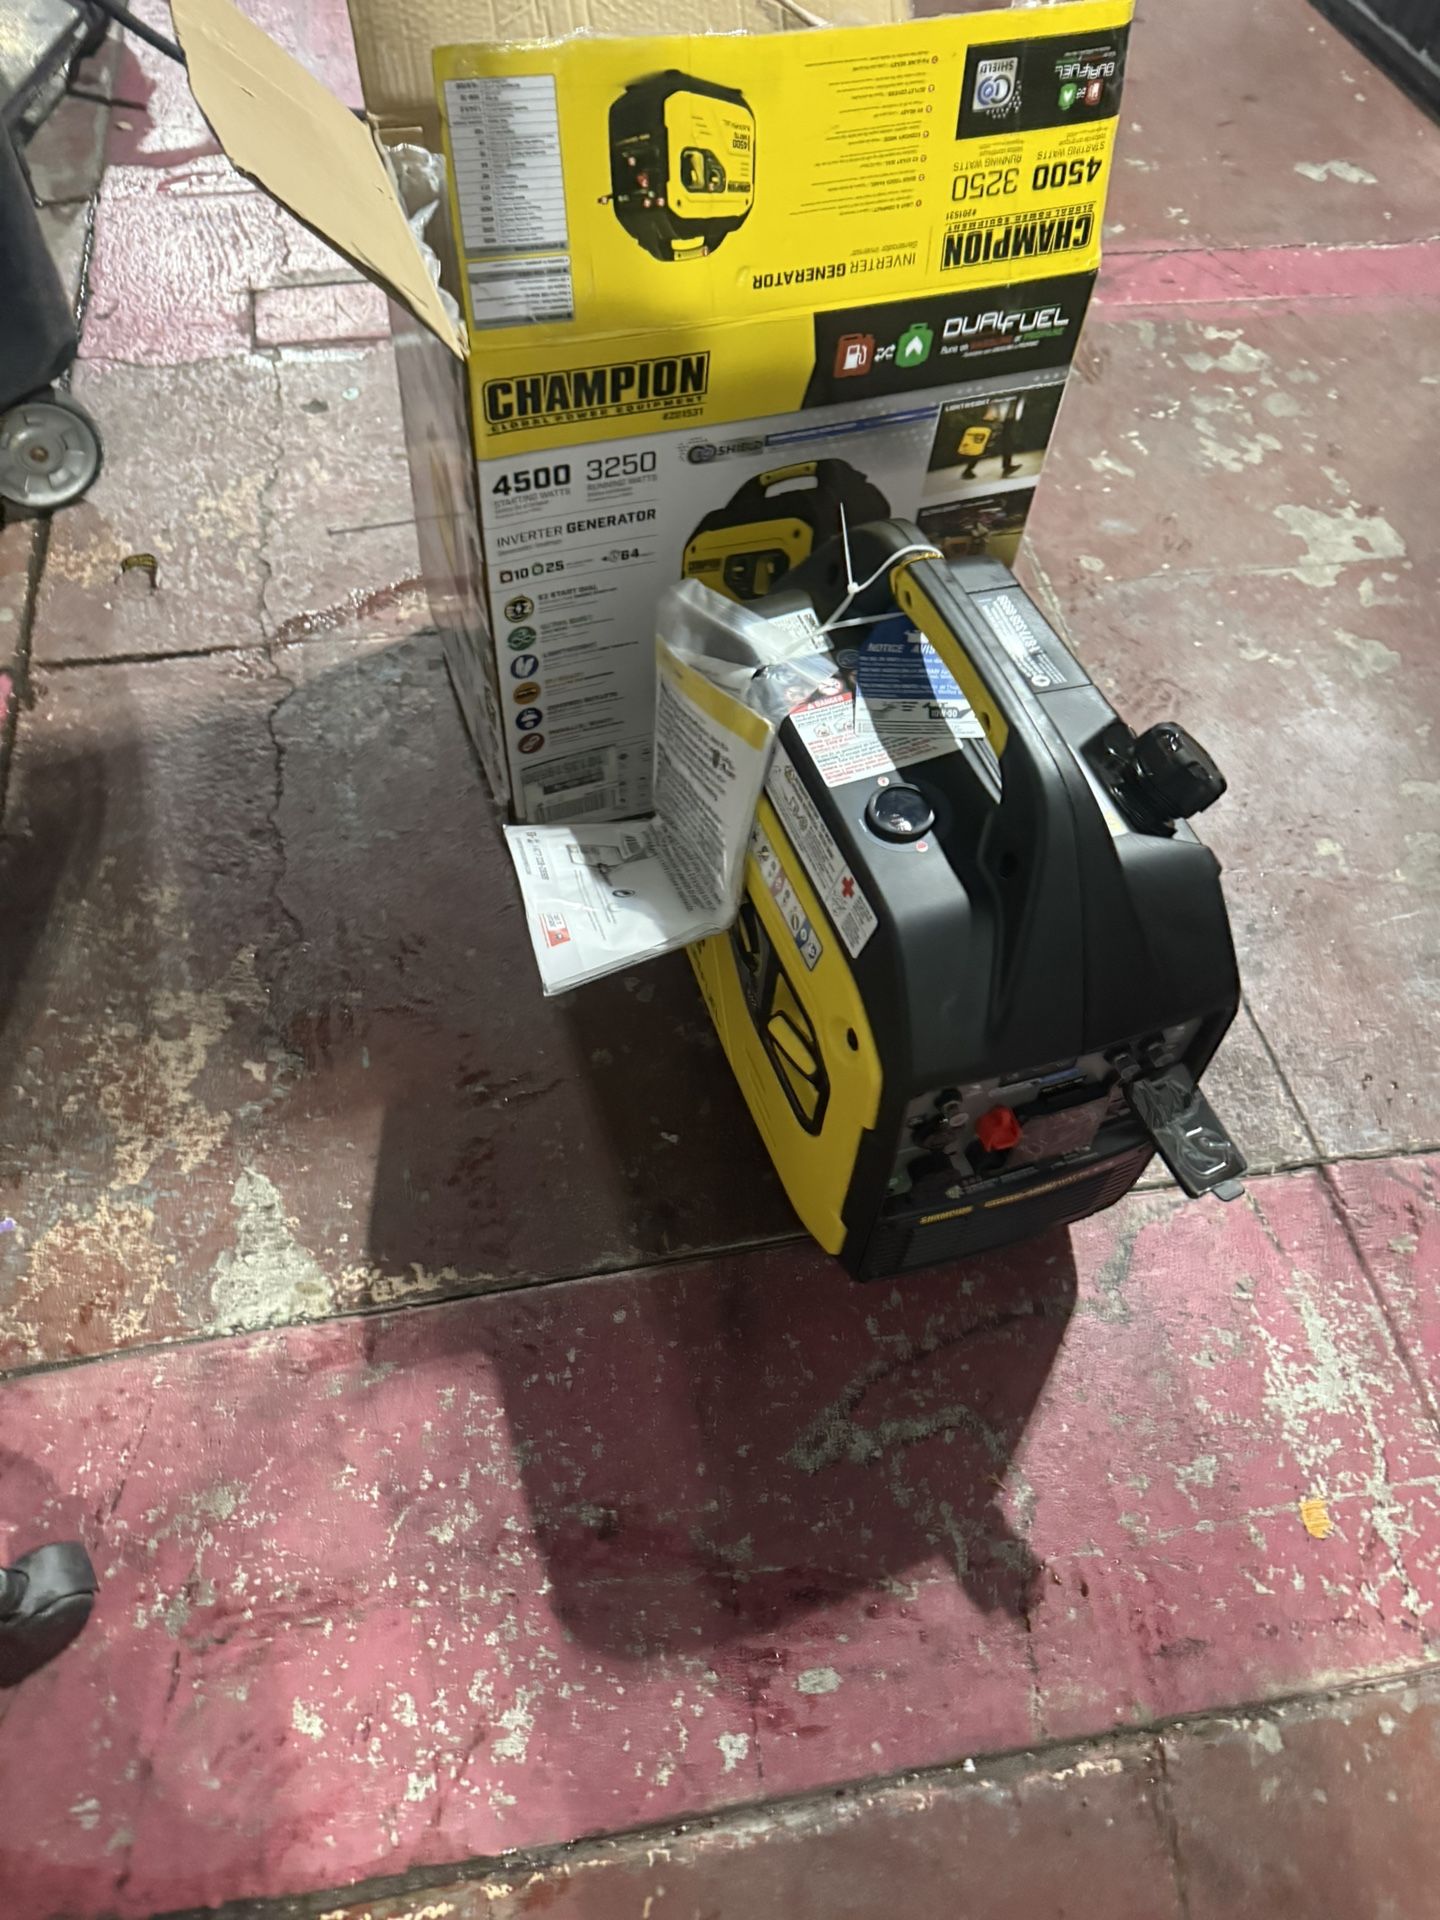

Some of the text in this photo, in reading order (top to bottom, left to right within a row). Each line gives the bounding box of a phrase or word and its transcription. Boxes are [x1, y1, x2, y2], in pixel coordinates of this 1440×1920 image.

[979, 60, 1015, 75] SHIELD
[1037, 147, 1067, 161] WATTS
[1066, 141, 1106, 157] STARTING
[952, 154, 1023, 172] RUNNING WATTS
[1031, 155, 1103, 191] 4500
[951, 167, 1020, 202] 3250
[945, 208, 977, 221] #201531
[947, 203, 1094, 233] GLOBAL POWER EQUIPMENT
[943, 212, 1094, 268] CHAMPION
[752, 252, 917, 290] INVERTER GENERATOR
[485, 353, 707, 422] CHAMPION
[490, 395, 704, 433] GLOBAL POWER EQUIPMENT
[586, 451, 658, 481] 3250
[492, 463, 571, 496] 4500
[494, 492, 538, 508] STARTING
[540, 487, 571, 499] WATTS
[496, 525, 563, 548] INVERTER
[566, 508, 658, 534] GENERATOR
[620, 547, 640, 562] 64
[513, 566, 530, 581] 10
[545, 560, 566, 574] 25
[867, 643, 905, 654] NOTICE
[815, 694, 845, 709] DANGER
